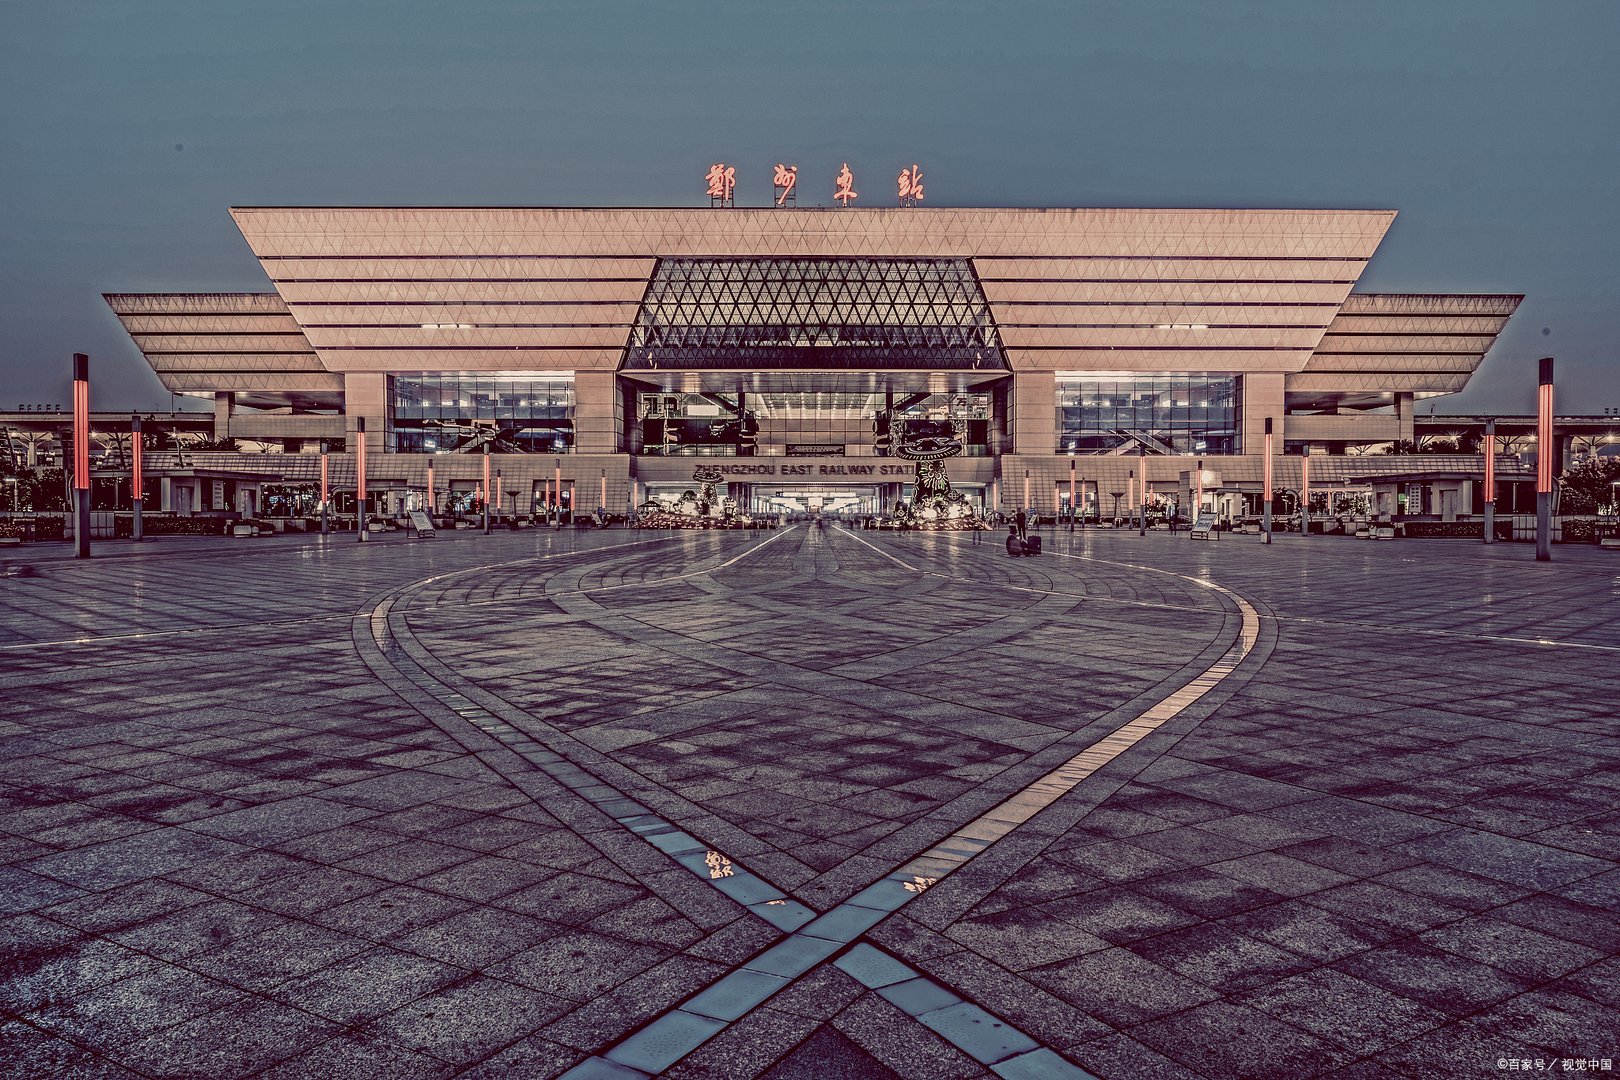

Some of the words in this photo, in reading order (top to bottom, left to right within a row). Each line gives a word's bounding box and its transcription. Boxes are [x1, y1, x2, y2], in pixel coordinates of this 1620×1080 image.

[695, 464, 775, 475] ZHENGZHOU
[781, 464, 813, 475] EAST
[820, 464, 876, 475] RAILWAY
[880, 464, 915, 475] STATI
